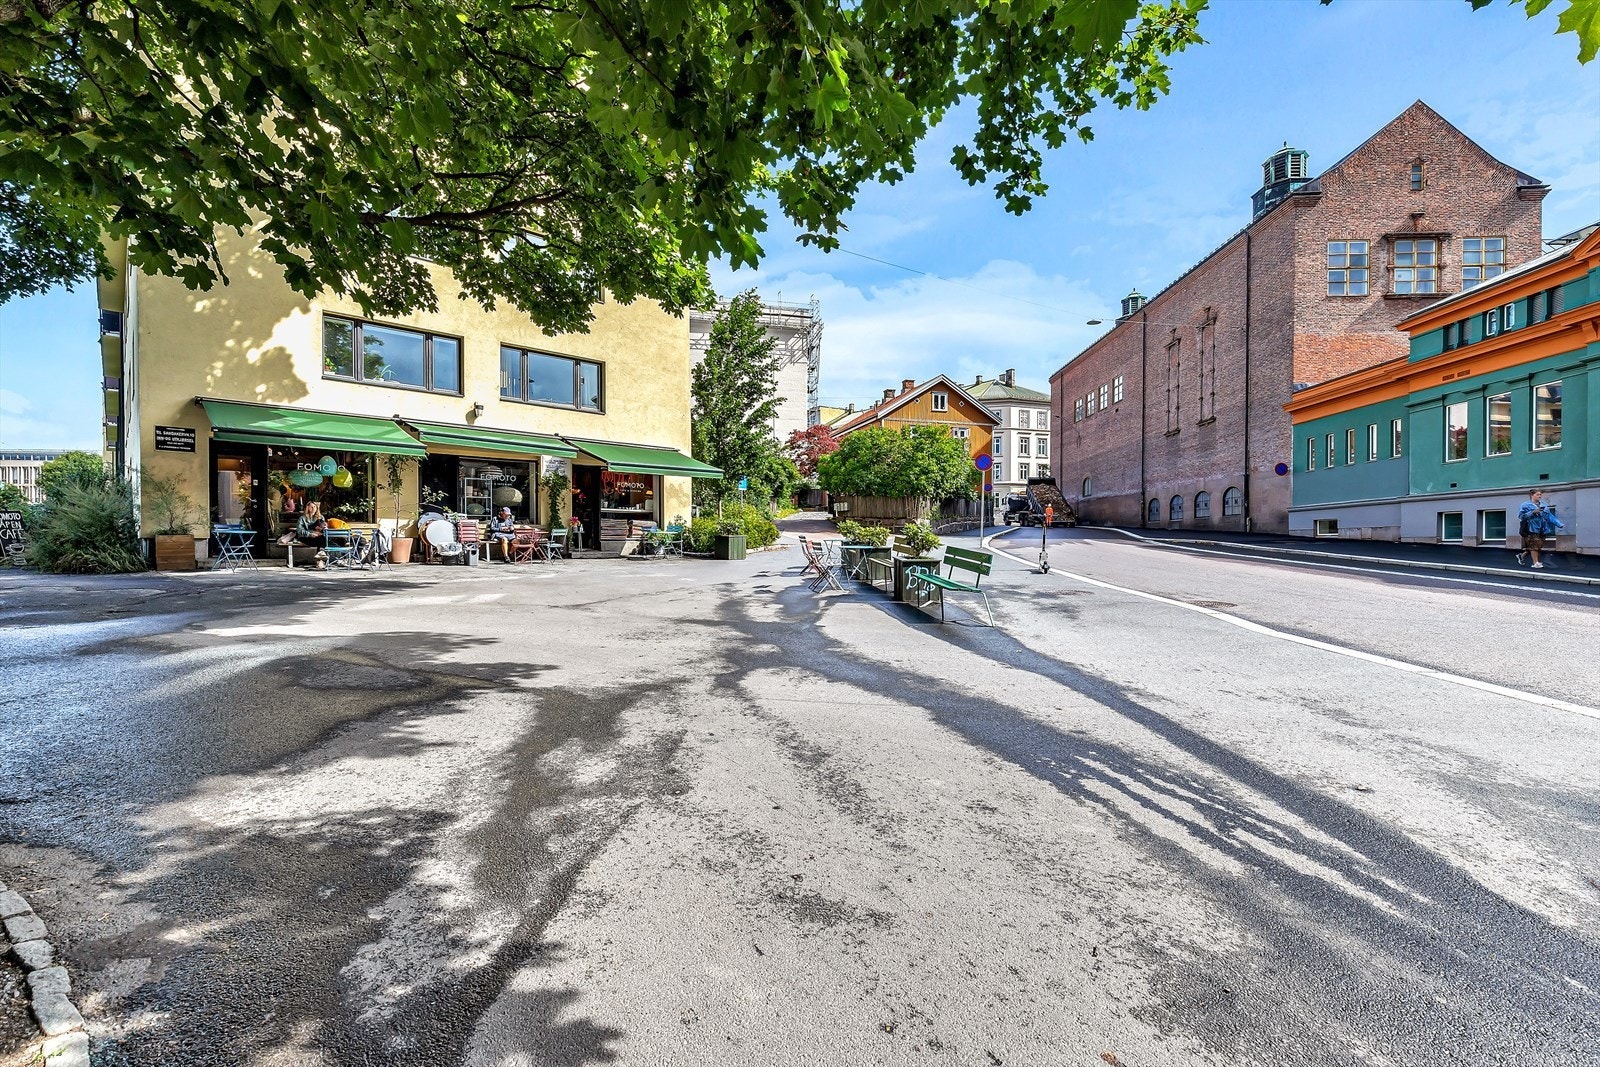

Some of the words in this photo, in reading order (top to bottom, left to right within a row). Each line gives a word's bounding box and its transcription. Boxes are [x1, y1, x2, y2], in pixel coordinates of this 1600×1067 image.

[297, 462, 346, 472] FOMOO
[480, 473, 517, 482] FOMOTO
[616, 481, 645, 489] FOMOTO
